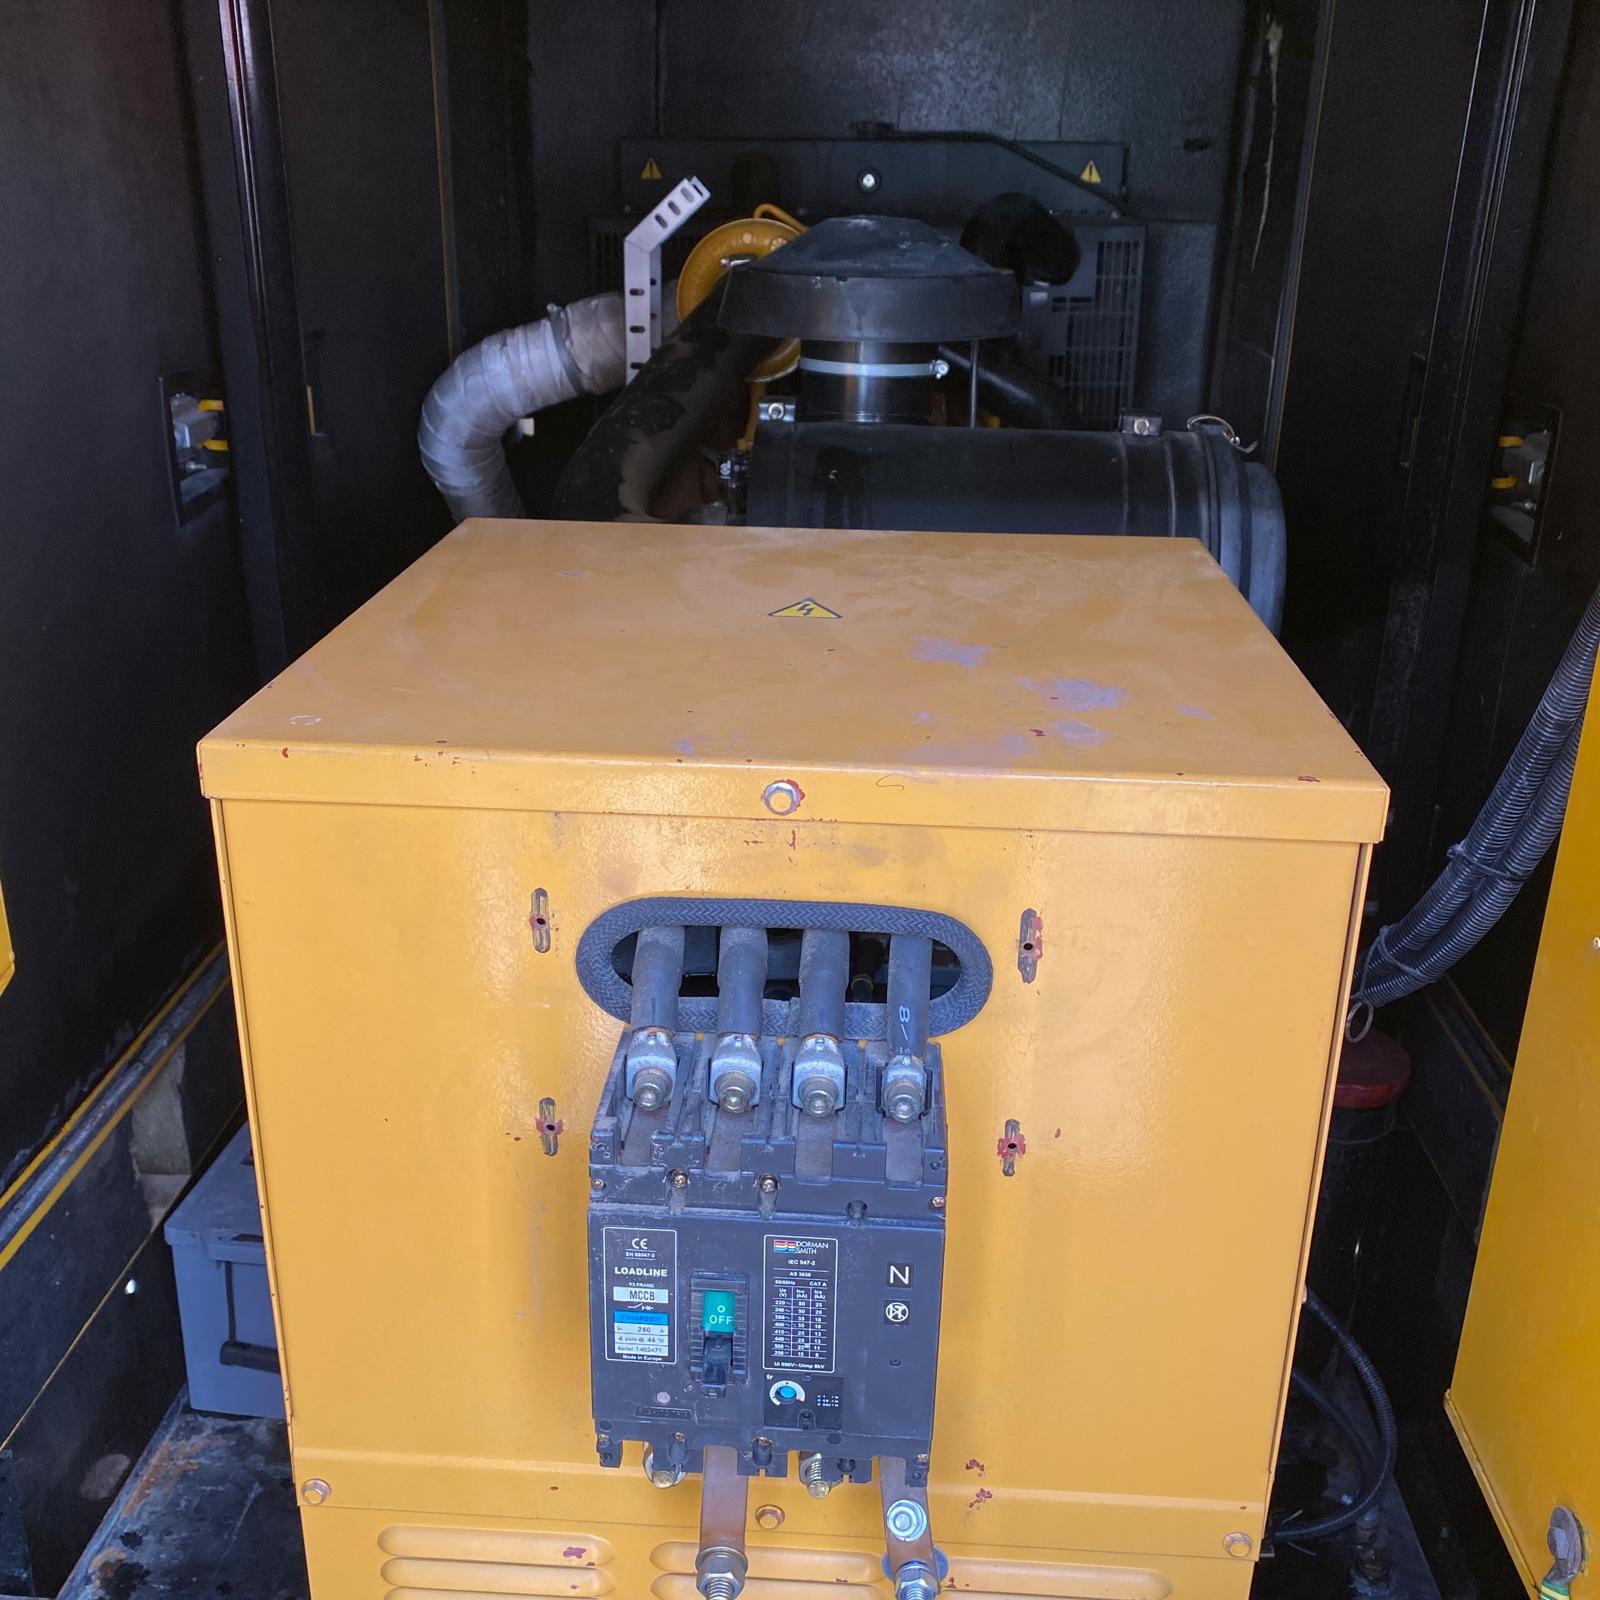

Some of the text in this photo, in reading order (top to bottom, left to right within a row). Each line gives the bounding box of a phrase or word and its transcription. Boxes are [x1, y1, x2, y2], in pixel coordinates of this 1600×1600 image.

[796, 1241, 829, 1249] DORMAN
[796, 1247, 817, 1255] SMITH
[614, 1266, 668, 1277] LOADLINE
[889, 1265, 909, 1285] N
[629, 1290, 656, 1301] MCCB
[708, 1315, 733, 1325] OFF
